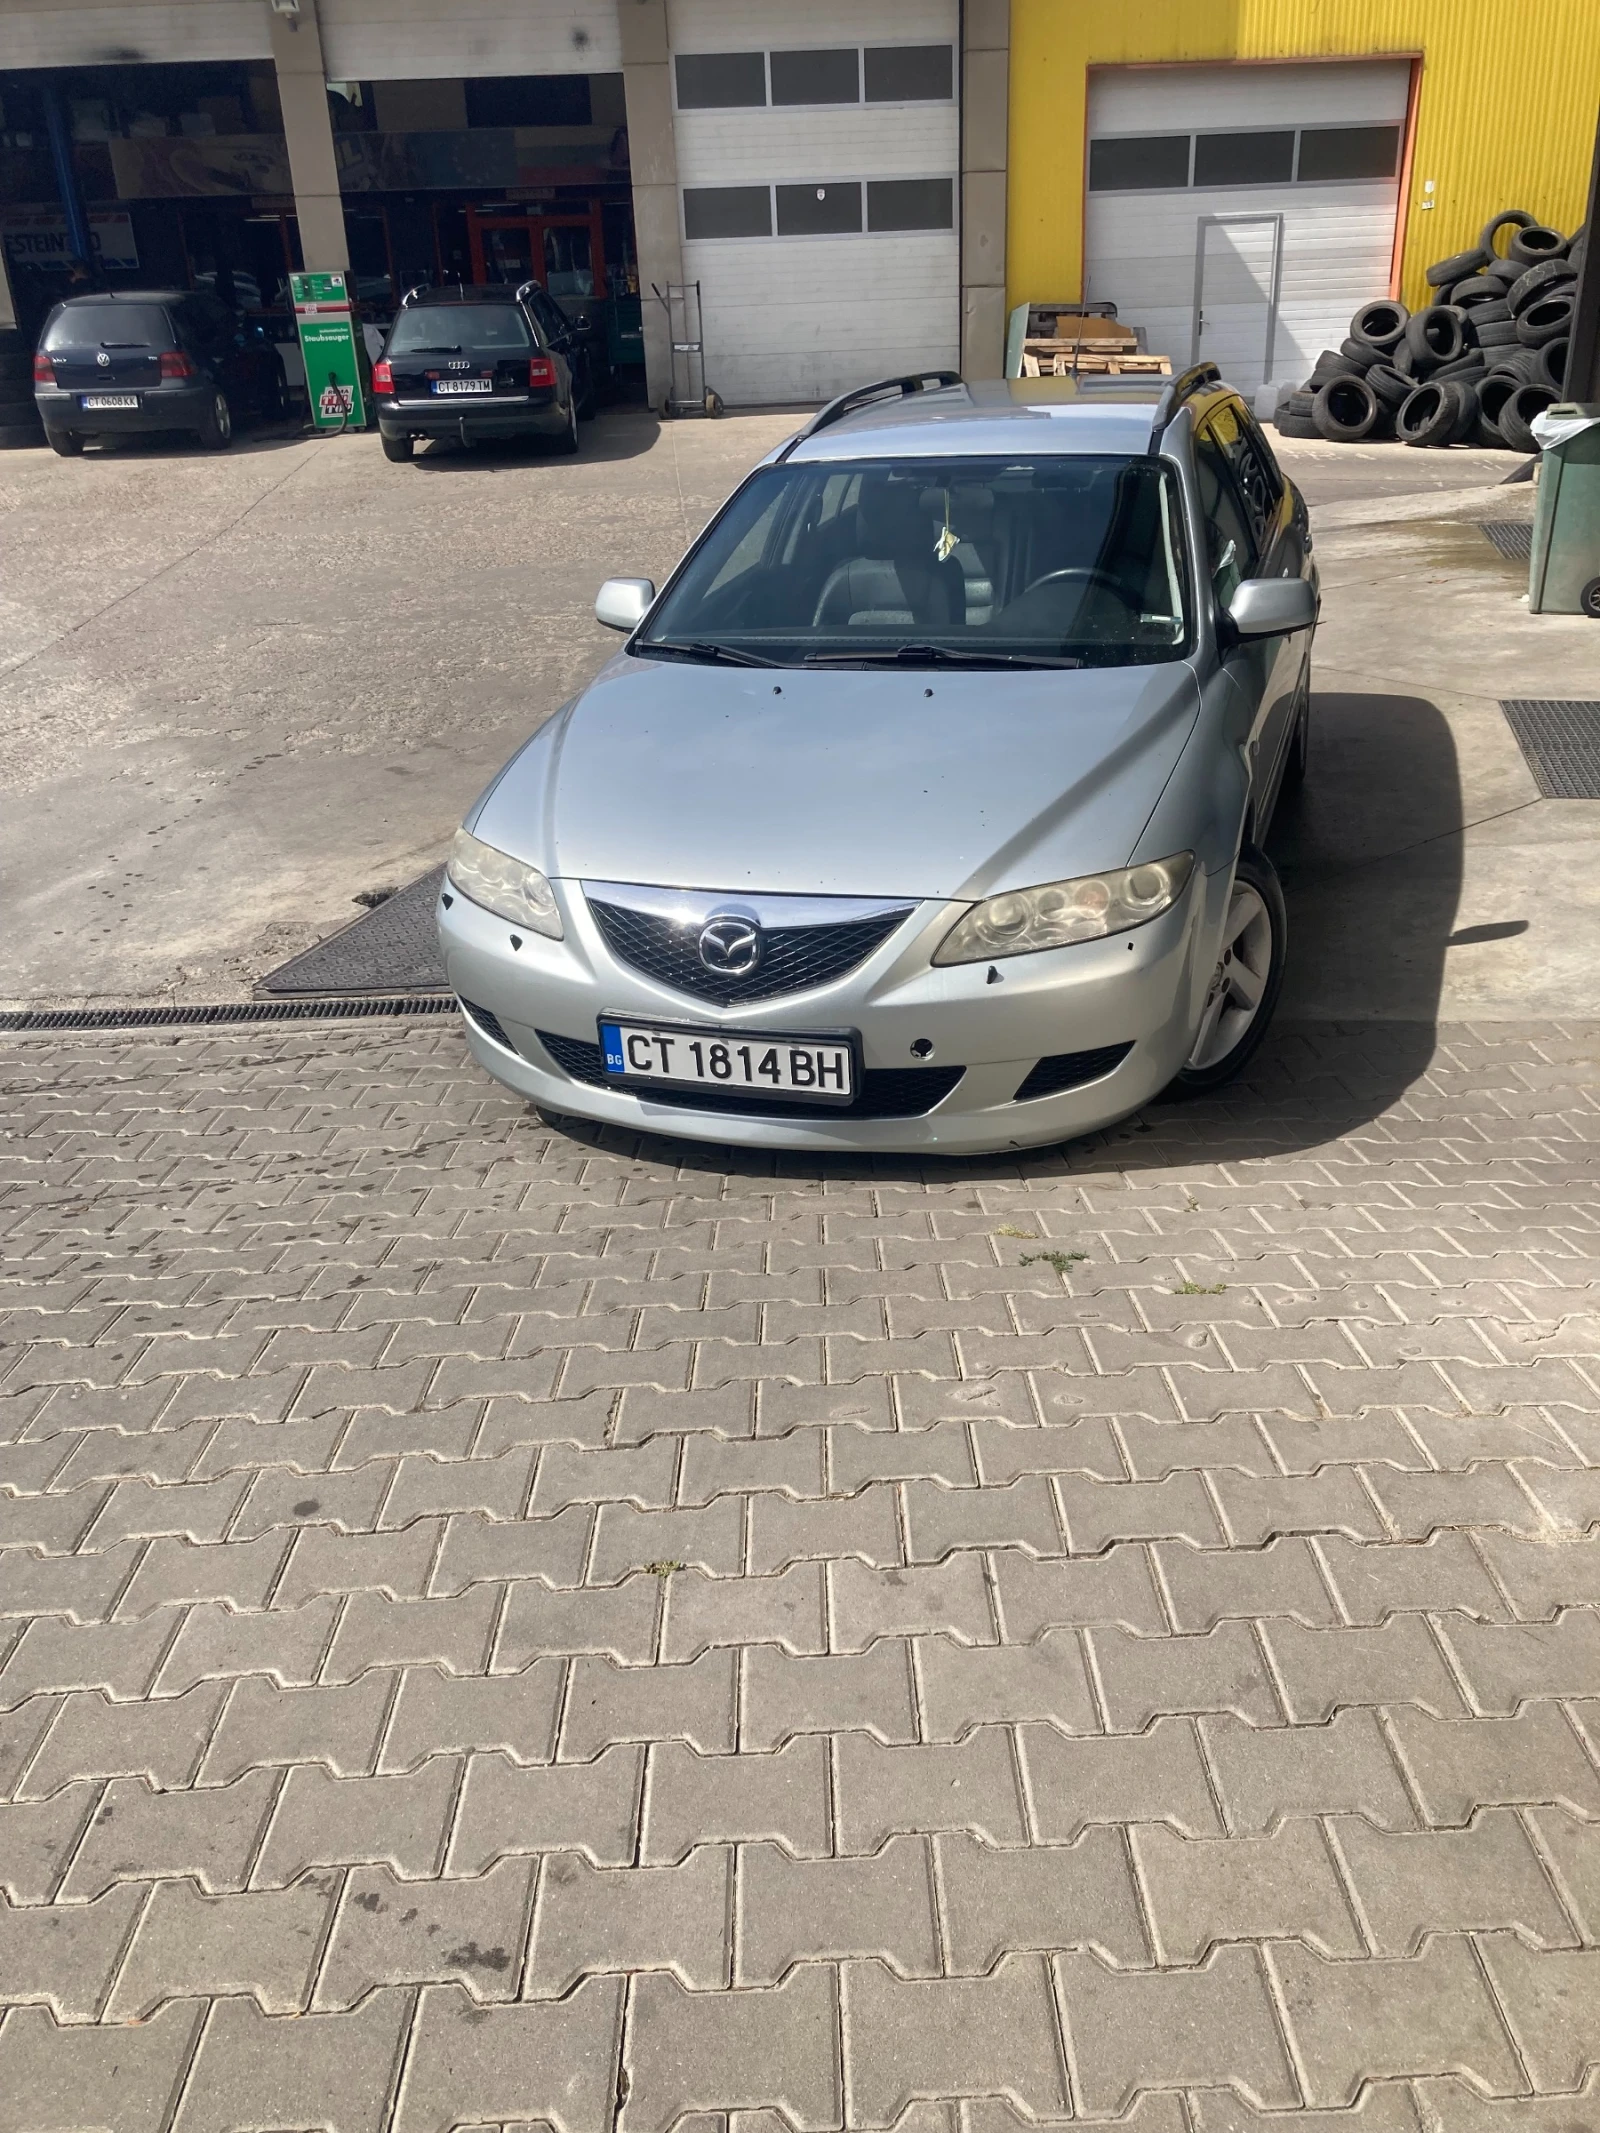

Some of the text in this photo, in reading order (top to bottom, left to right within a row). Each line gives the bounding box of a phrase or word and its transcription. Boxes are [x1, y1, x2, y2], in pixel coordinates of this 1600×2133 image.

[304, 334, 350, 342] Staubsauger
[439, 380, 490, 393] CT 8179 TM
[88, 396, 136, 407] CT 0608 KK
[606, 1053, 623, 1066] BG
[626, 1034, 844, 1090] CT 1814 BH
